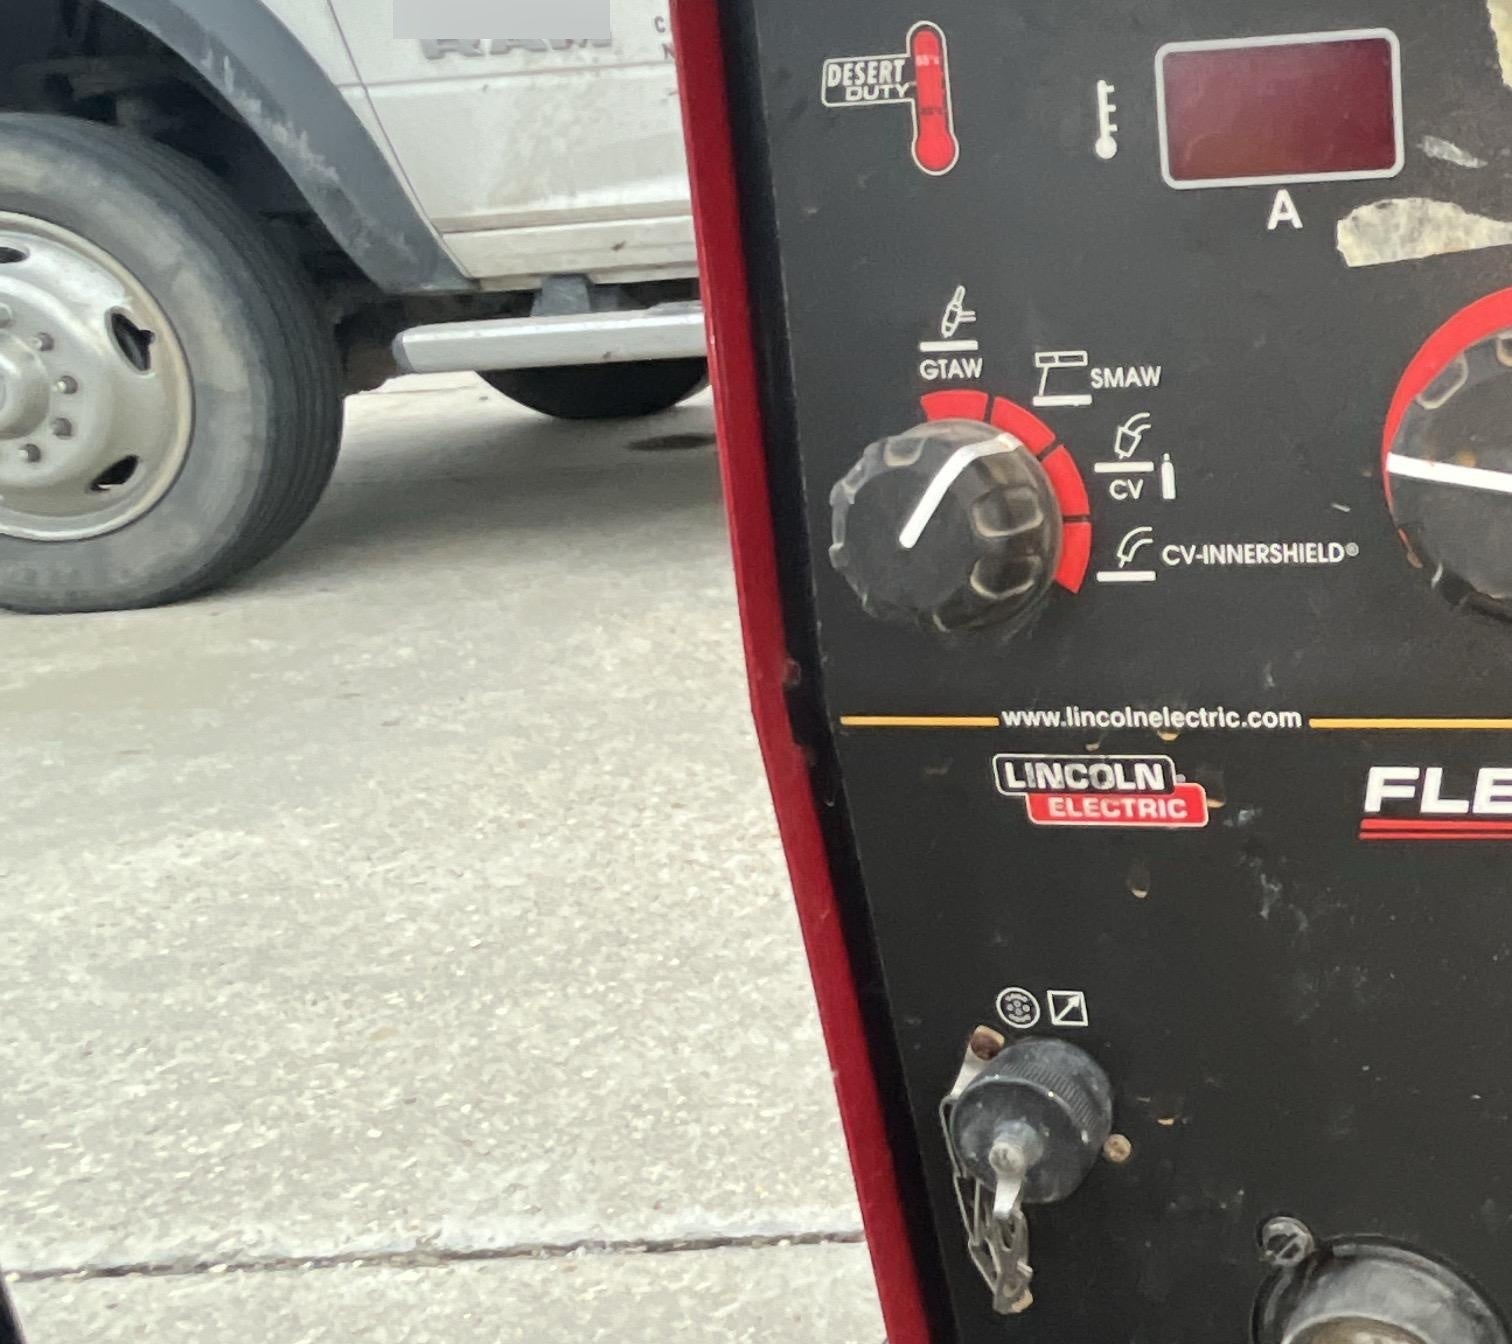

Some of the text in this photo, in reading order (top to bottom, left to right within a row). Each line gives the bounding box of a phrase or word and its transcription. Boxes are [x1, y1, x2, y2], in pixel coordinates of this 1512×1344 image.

[826, 59, 907, 88] DESERT
[845, 83, 910, 102] DUTY
[1267, 188, 1304, 230] A
[919, 357, 983, 381] GTAW
[1090, 365, 1162, 389] SMAW
[1109, 478, 1144, 501] CV
[1000, 705, 1303, 730] www.lincolnelectric.com
[1004, 761, 1165, 791] LINCOLN
[1047, 796, 1188, 820] ELECTRIC
